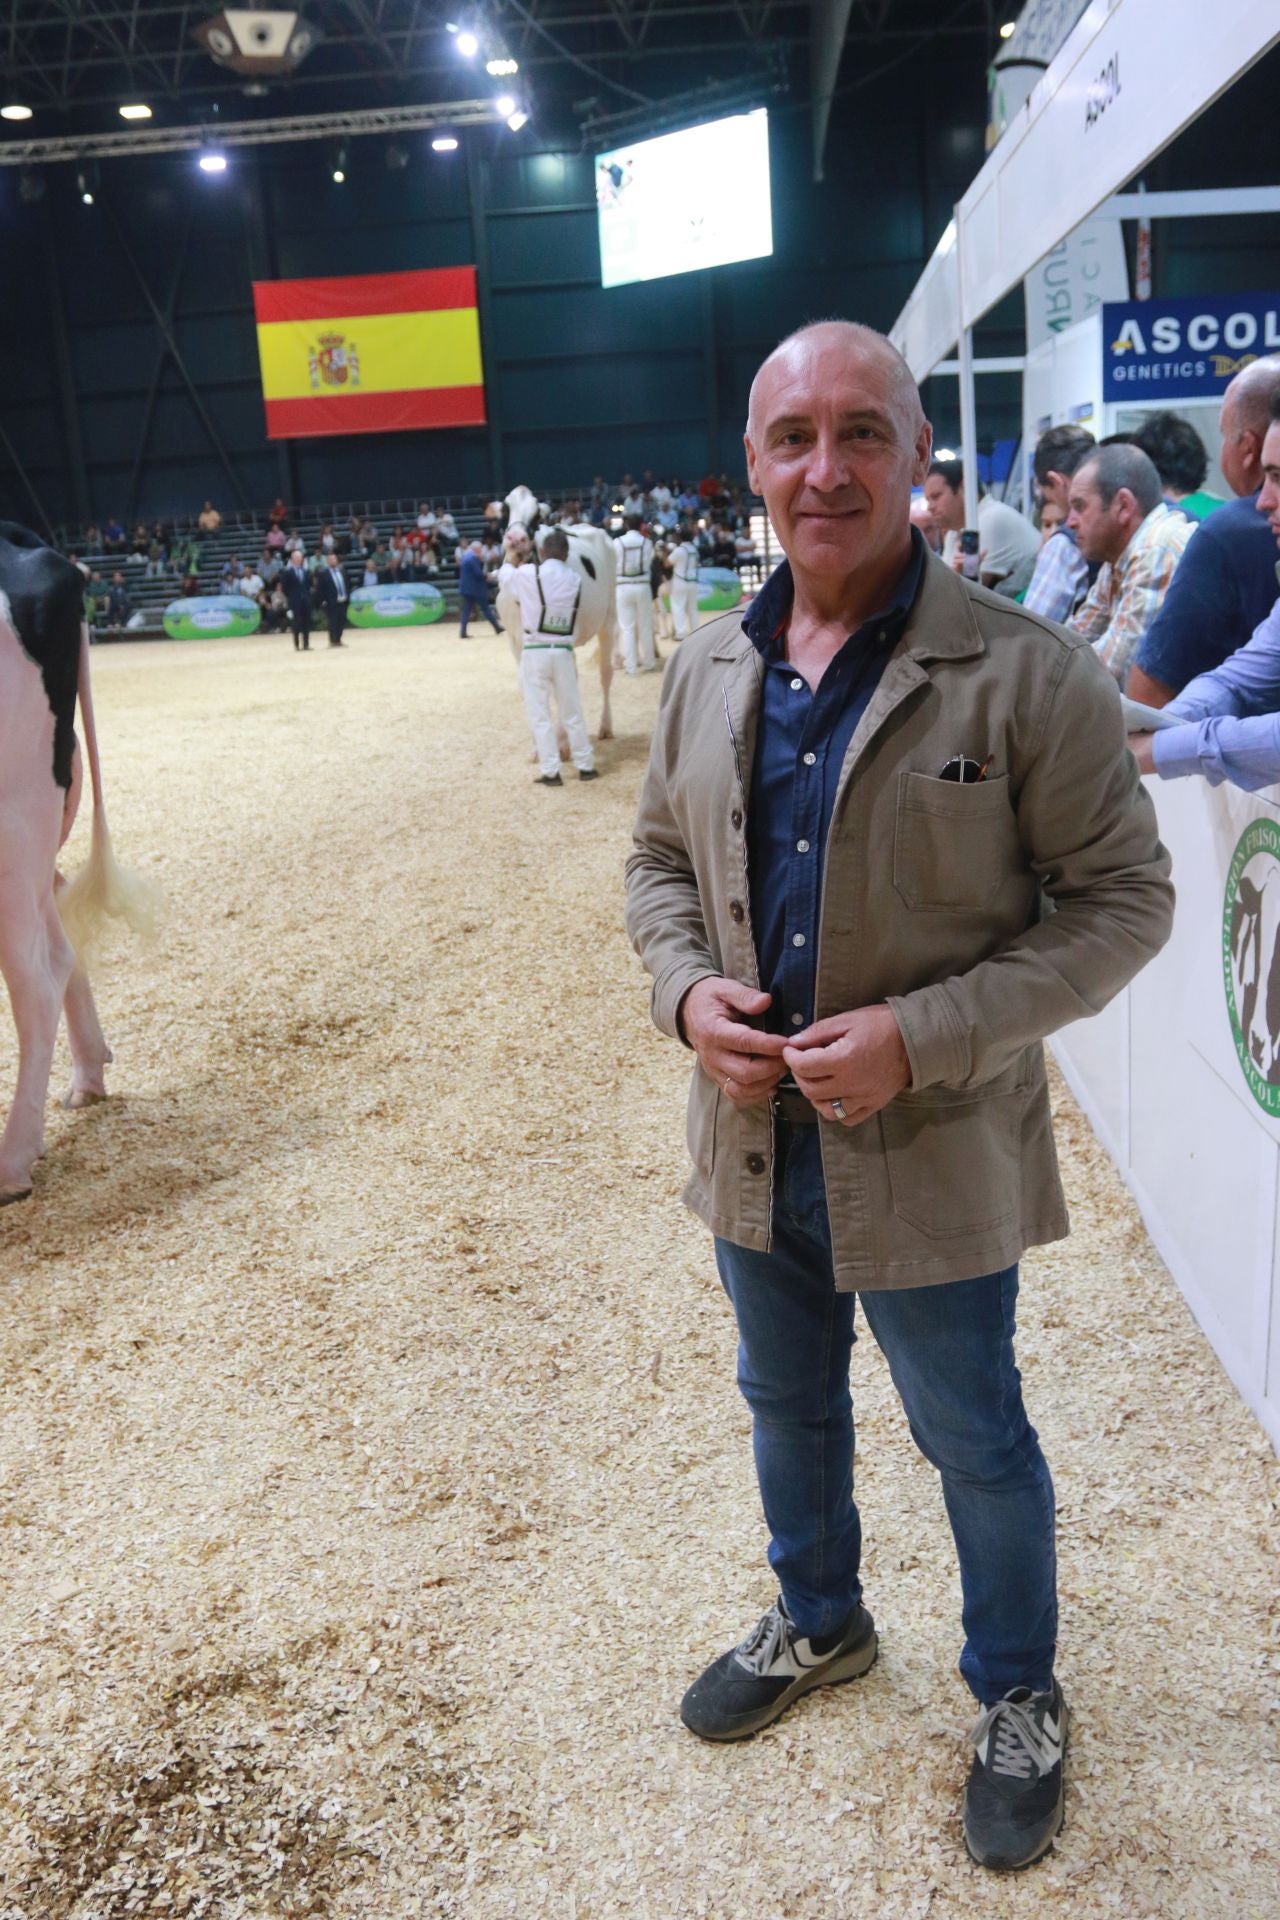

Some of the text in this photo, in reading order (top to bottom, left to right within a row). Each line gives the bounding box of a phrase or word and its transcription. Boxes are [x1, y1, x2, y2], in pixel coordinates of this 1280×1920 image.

[1111, 311, 1280, 356] ASCOL
[1112, 360, 1206, 382] GENETICS
[1246, 826, 1280, 855] FRISO
